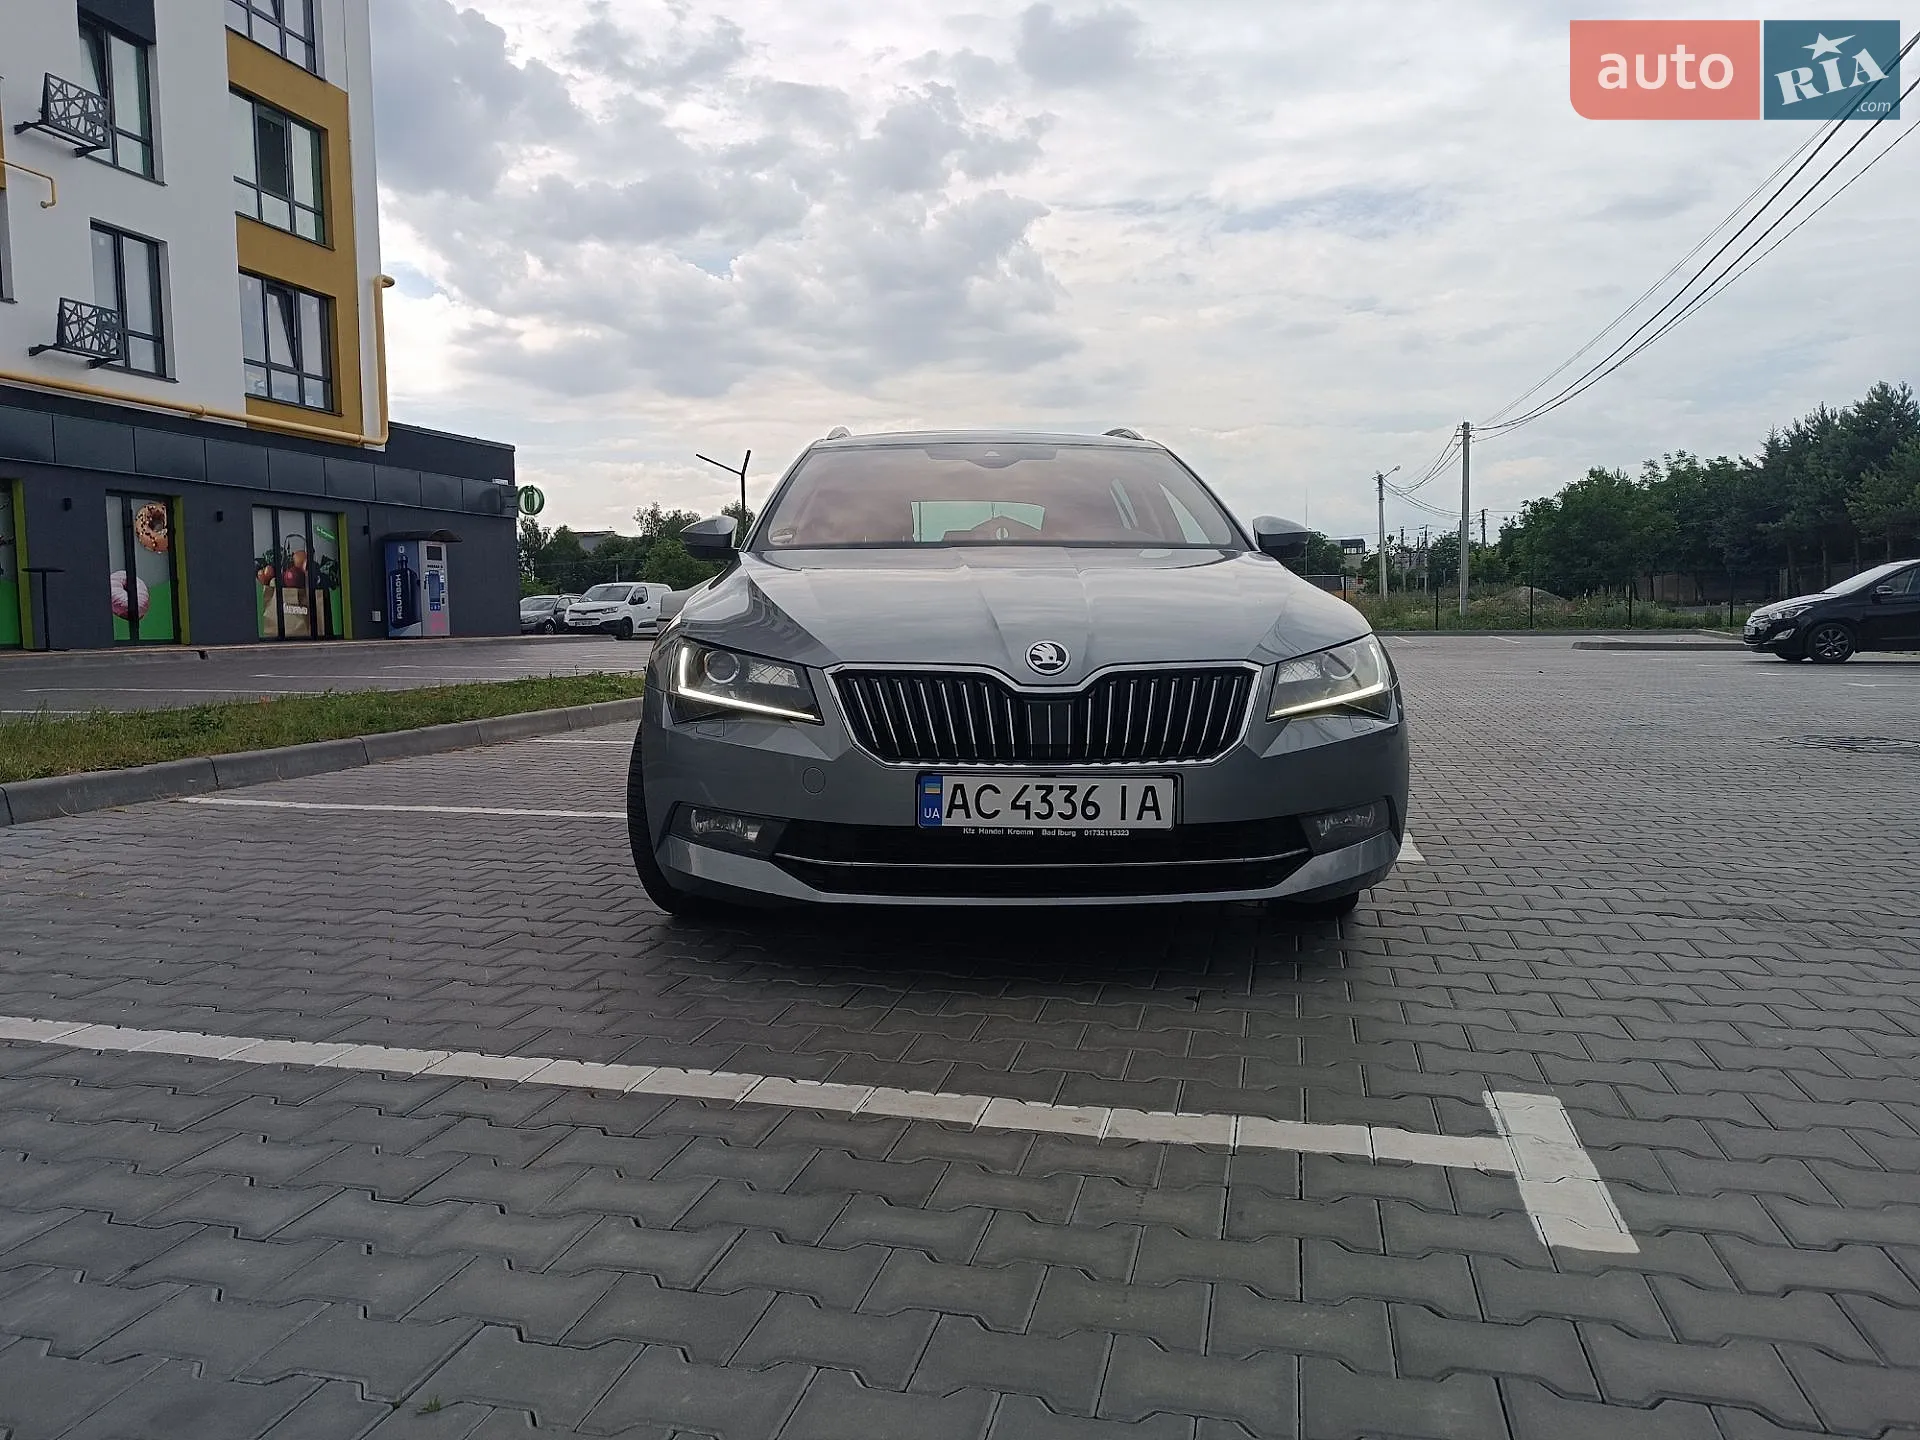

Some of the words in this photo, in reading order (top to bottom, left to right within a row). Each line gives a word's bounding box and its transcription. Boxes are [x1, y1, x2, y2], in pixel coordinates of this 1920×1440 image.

[945, 783, 1001, 820] AC
[1010, 784, 1101, 821] 4336
[1120, 785, 1162, 821] IA
[924, 808, 940, 819] UA
[978, 827, 1004, 836] Handel
[1041, 828, 1056, 836] Bad
